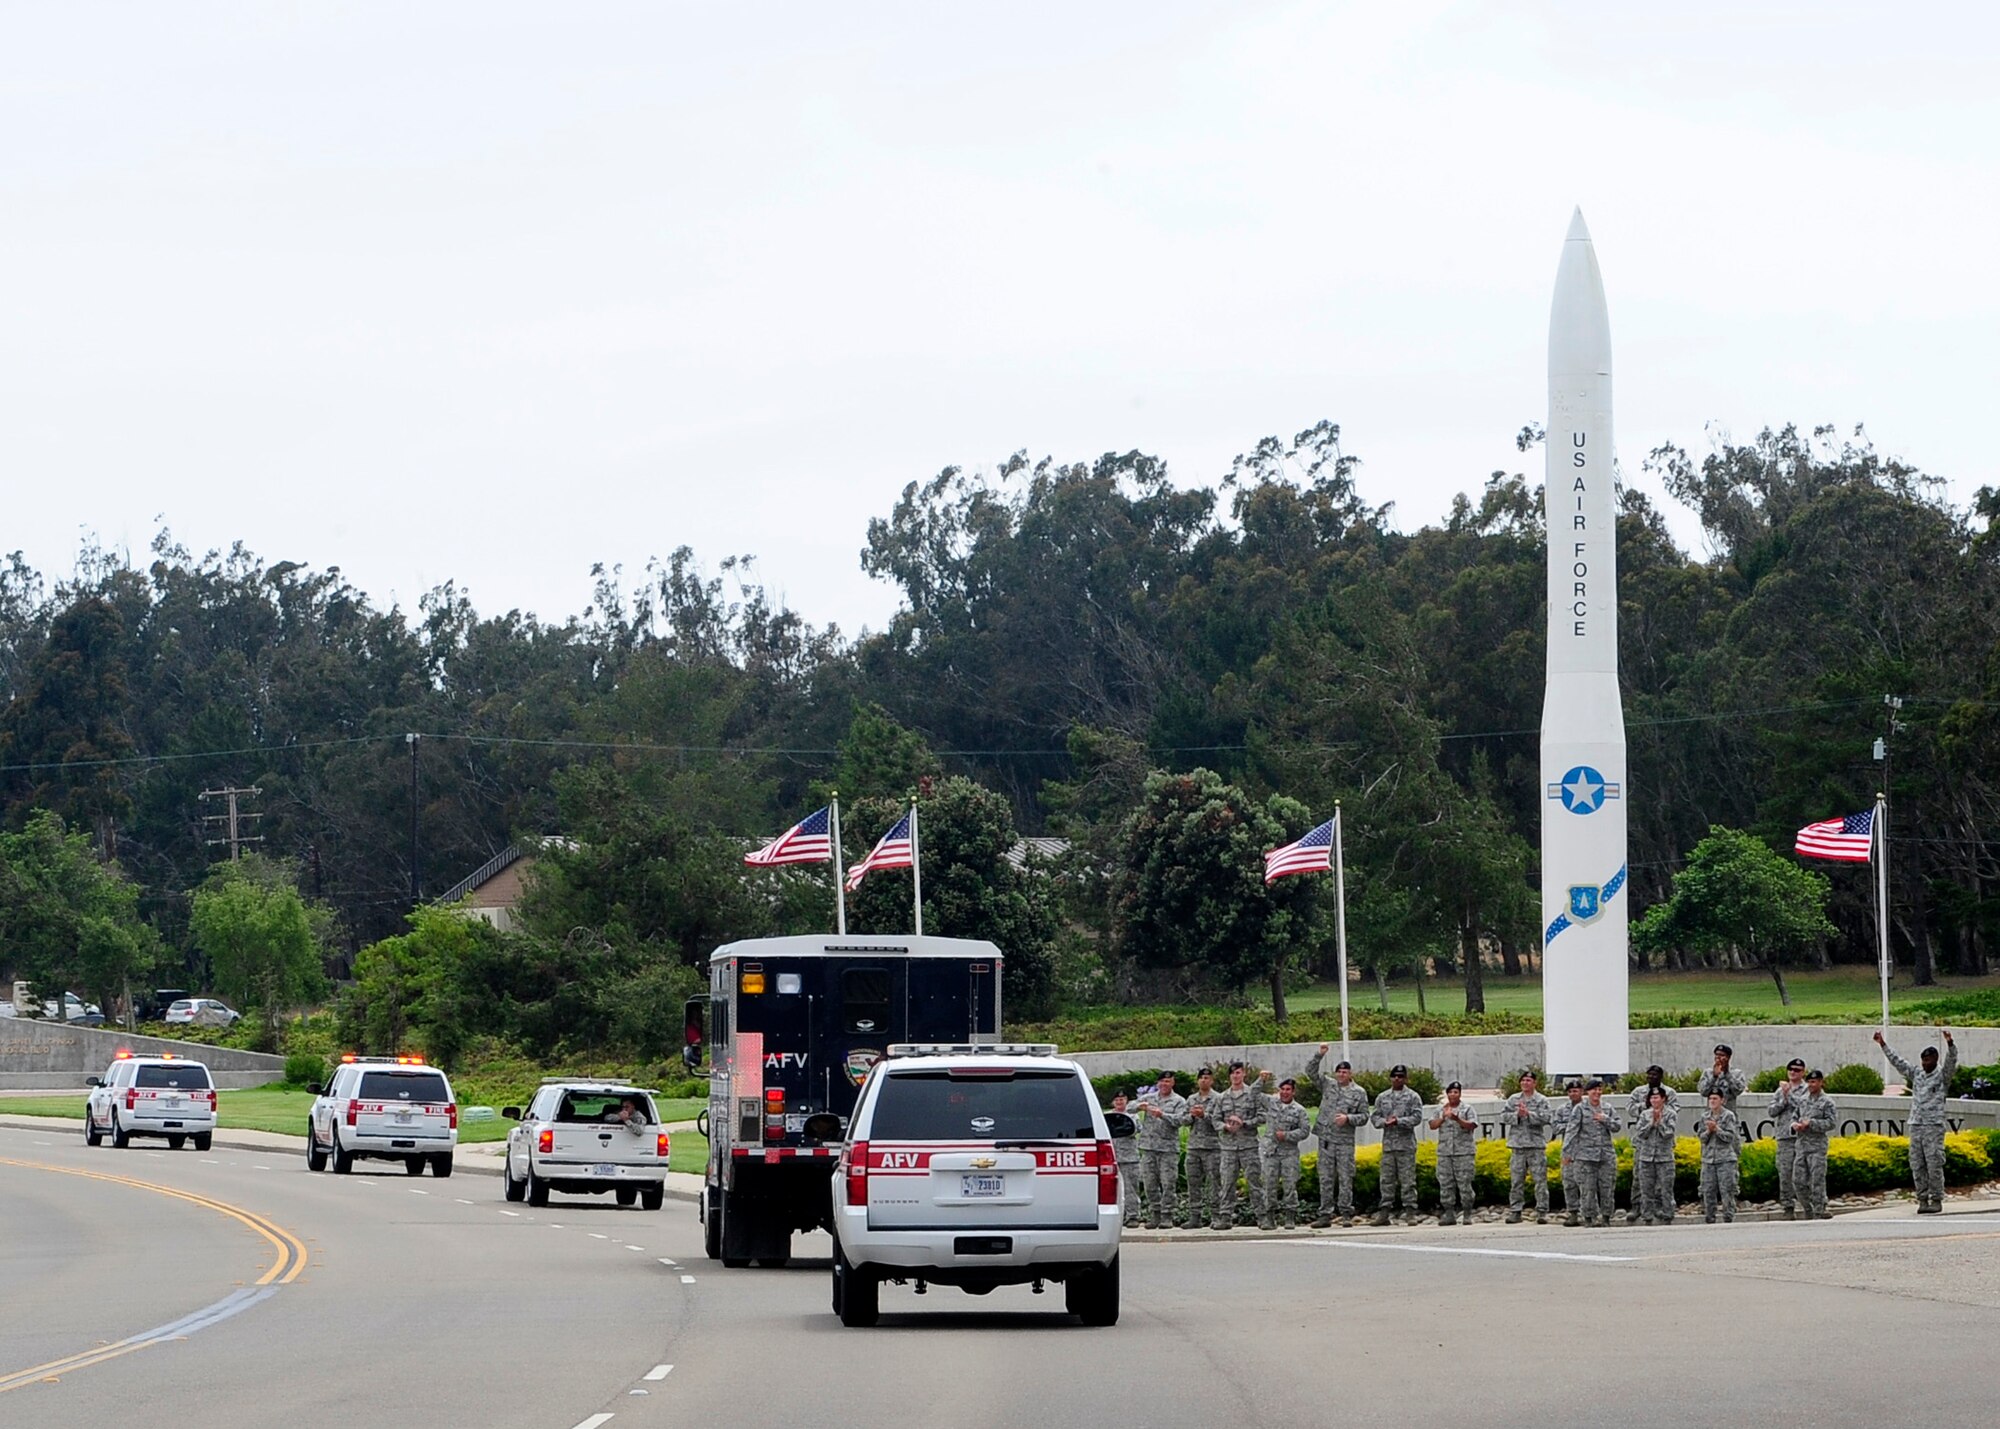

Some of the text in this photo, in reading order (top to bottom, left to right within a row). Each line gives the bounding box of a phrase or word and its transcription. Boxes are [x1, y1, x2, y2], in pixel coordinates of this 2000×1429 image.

[1573, 432, 1587, 636] US AIR FORCE
[765, 1053, 808, 1068] AFV
[881, 1152, 1086, 1168] AFV FIRE
